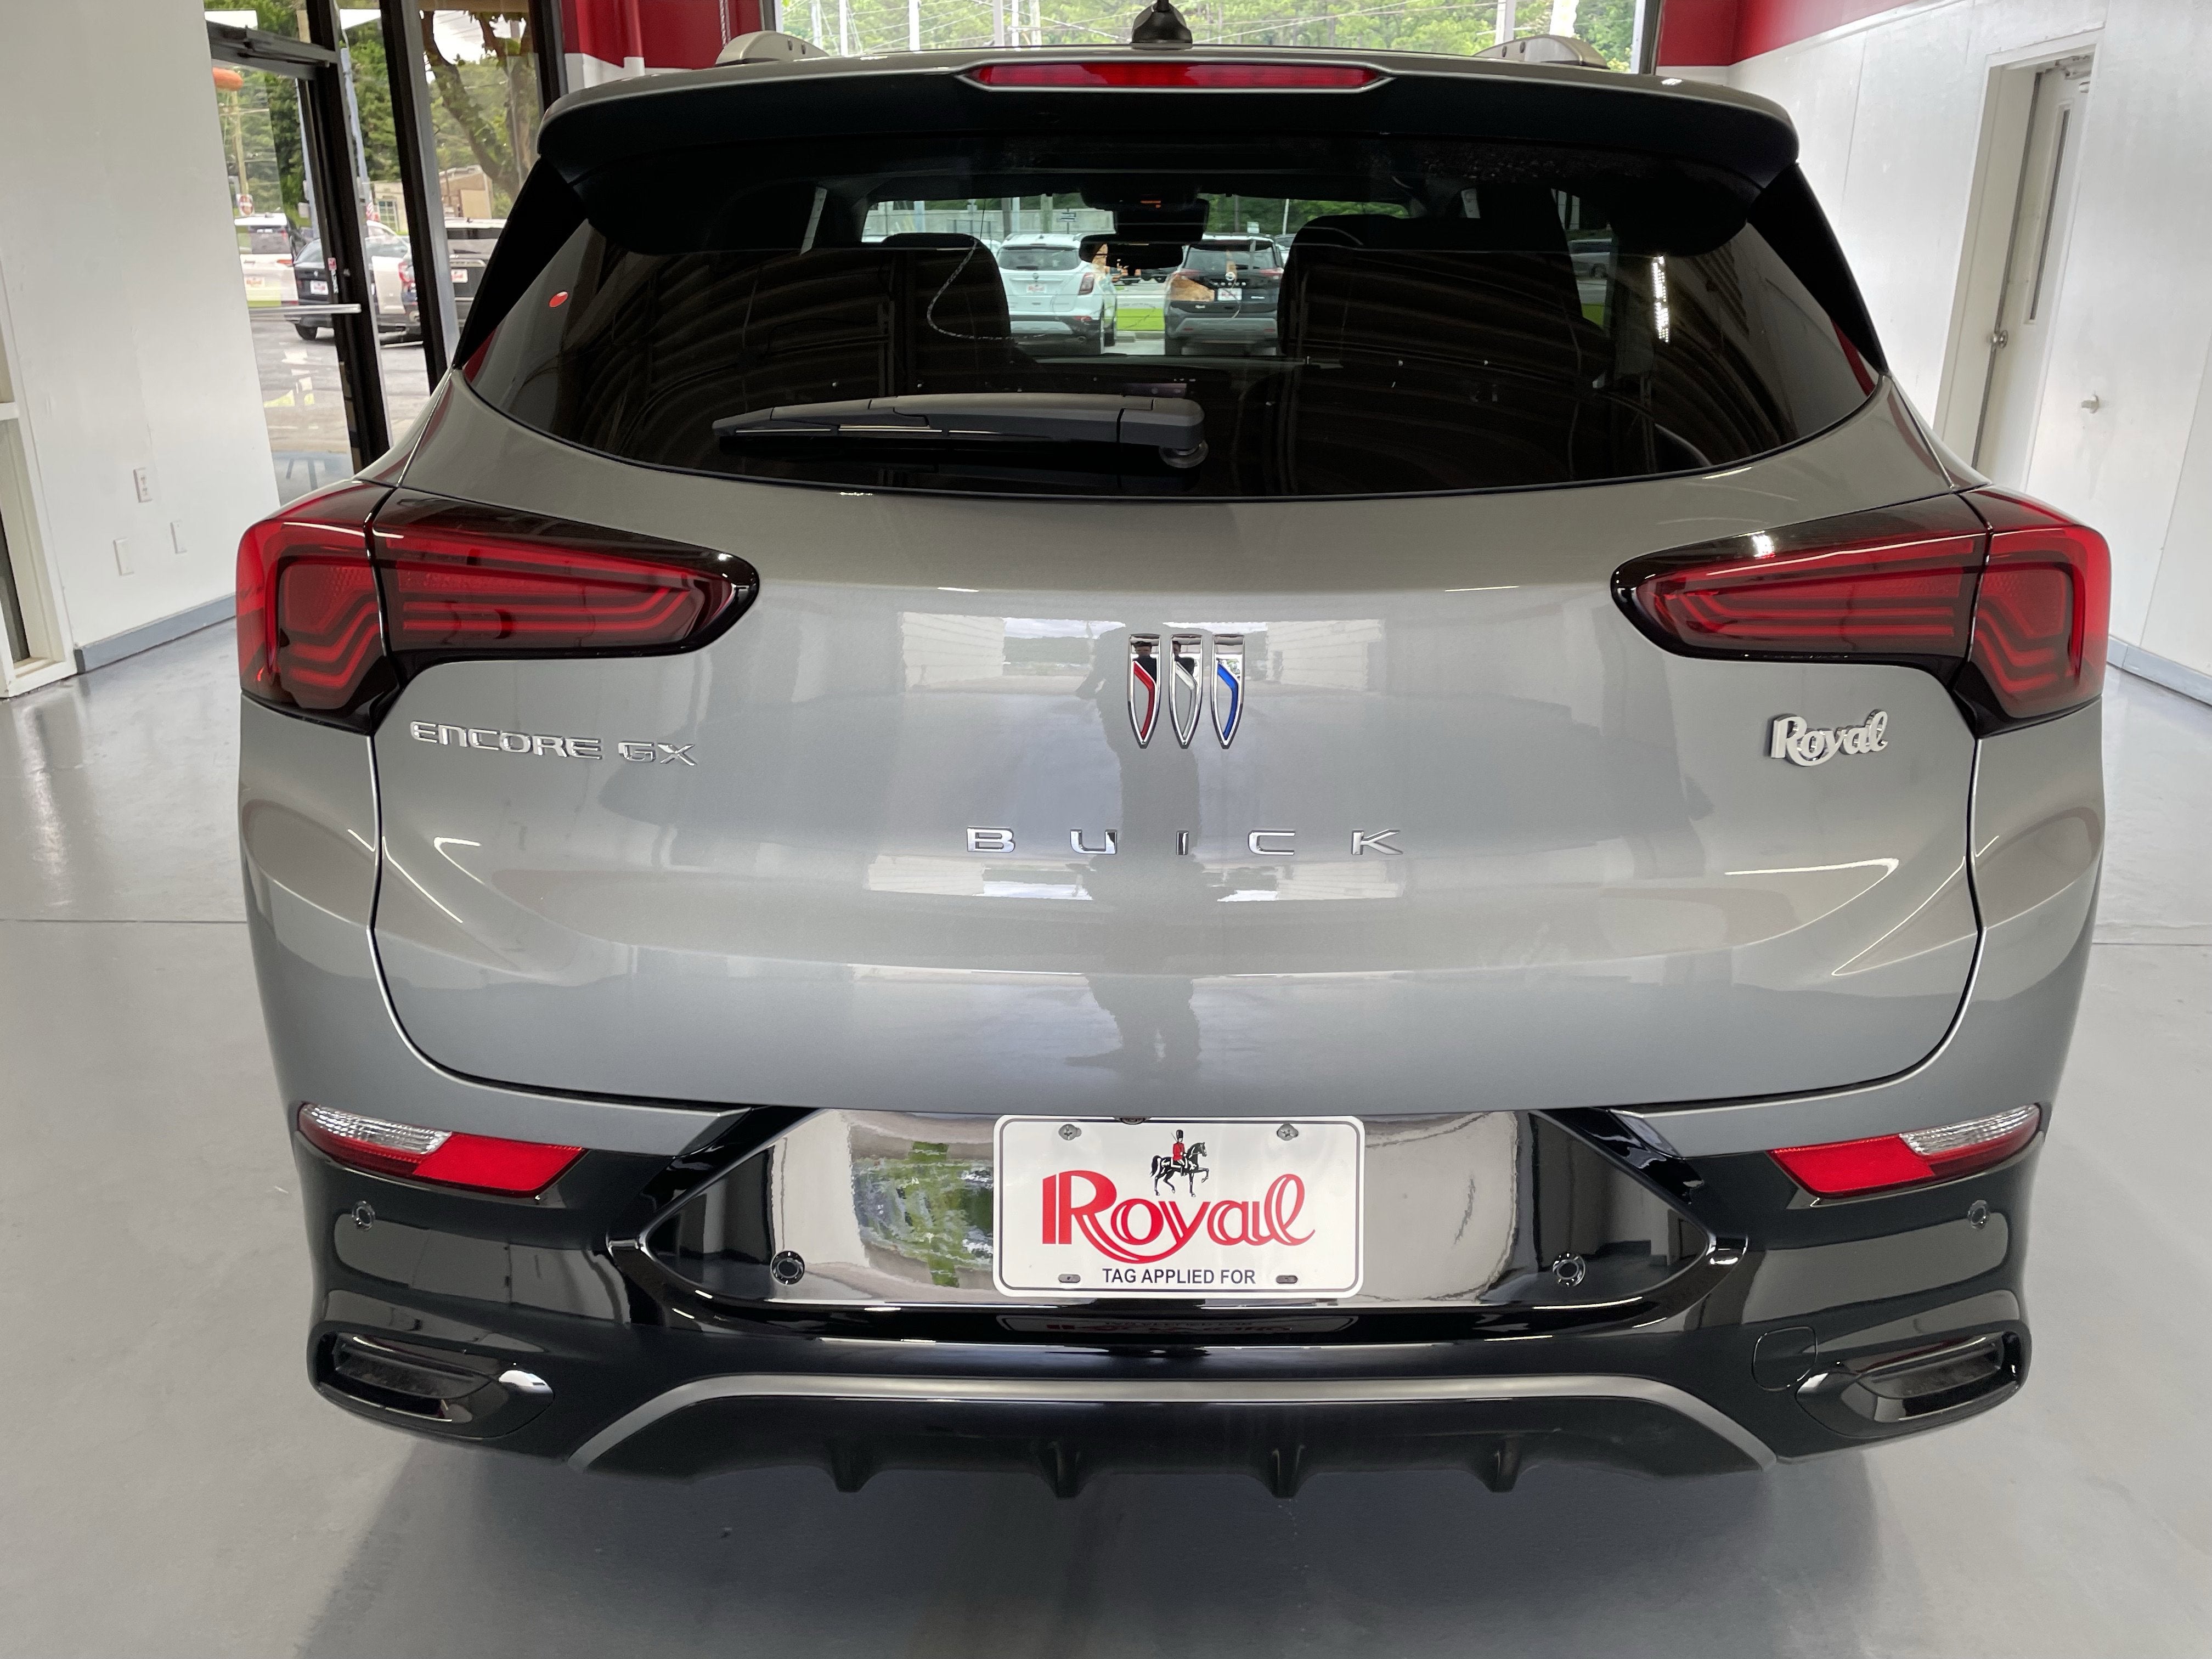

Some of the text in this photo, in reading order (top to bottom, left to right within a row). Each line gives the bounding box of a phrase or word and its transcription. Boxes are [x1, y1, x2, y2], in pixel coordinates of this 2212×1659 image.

[410, 720, 698, 766] ENCORE GX
[1769, 710, 1888, 766] Royal
[966, 826, 1404, 856] BUICK
[1042, 1170, 1316, 1264] Royal
[1102, 1268, 1256, 1284] TAG APPLIED FOR
